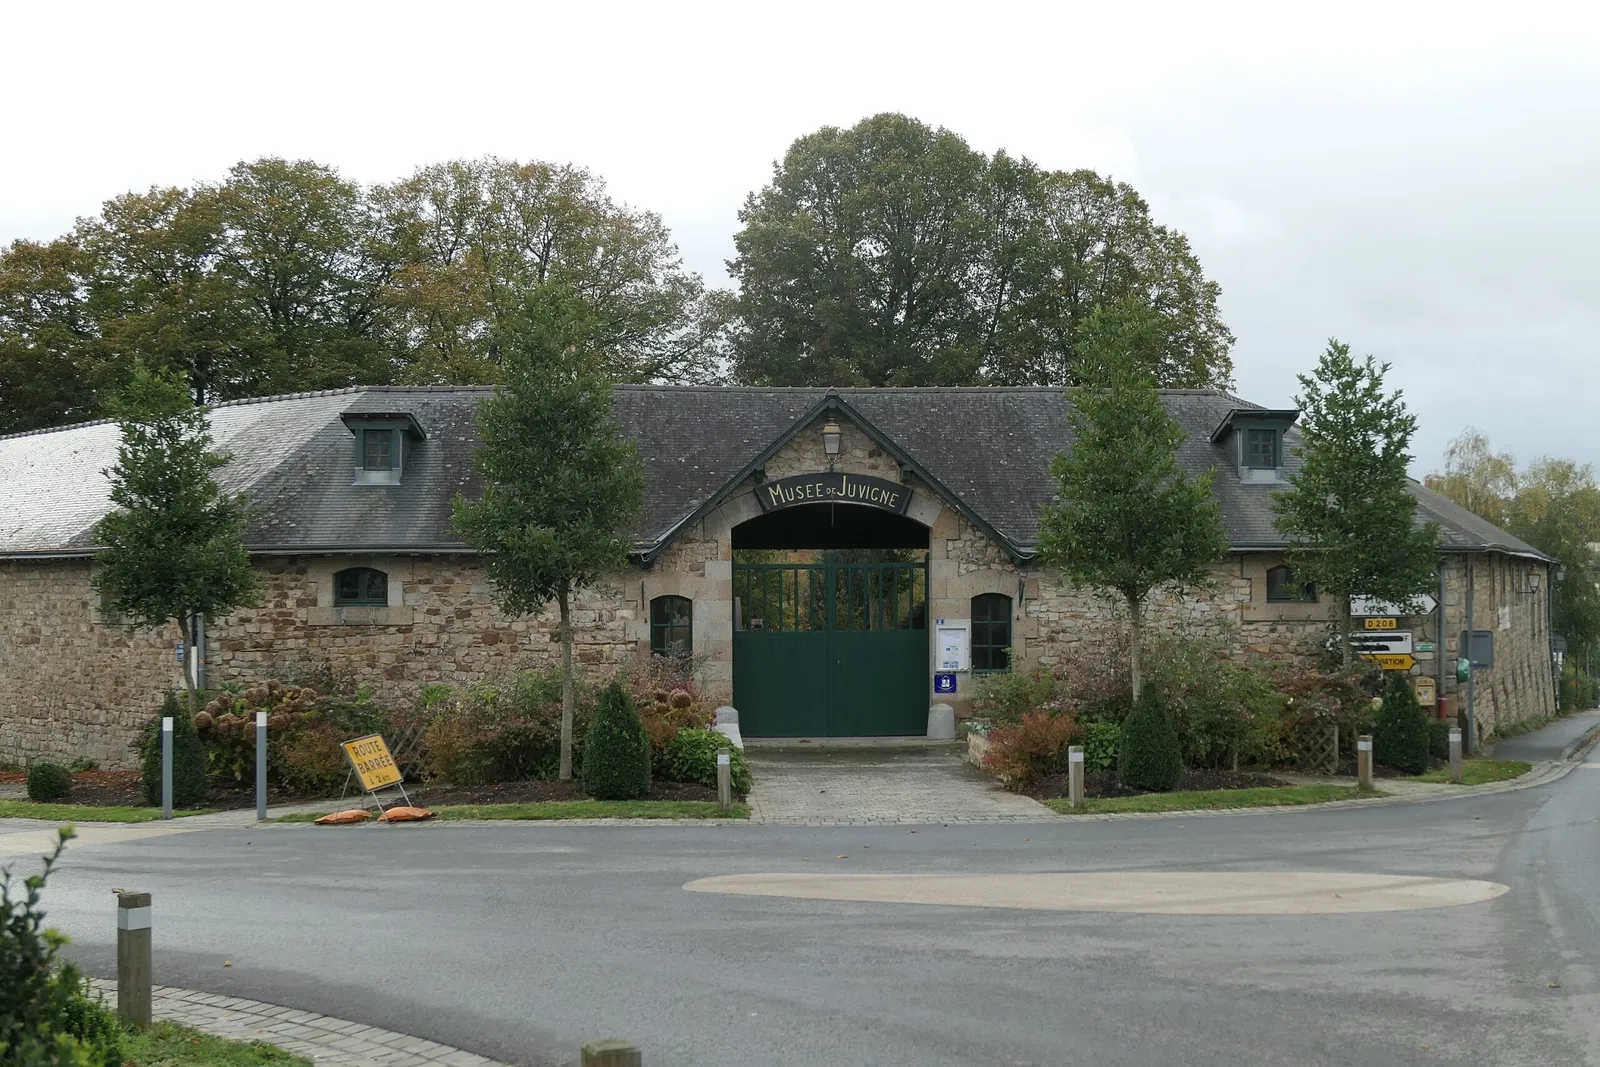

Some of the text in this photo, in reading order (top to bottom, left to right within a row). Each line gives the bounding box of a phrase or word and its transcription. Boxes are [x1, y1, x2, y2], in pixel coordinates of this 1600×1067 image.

[768, 475, 900, 508] MUSÉE DE JUVIGNÉ
[1368, 620, 1394, 628] D 208
[352, 741, 382, 757] ROUTE
[357, 753, 393, 774] BARRÉE
[376, 775, 382, 783] 2
